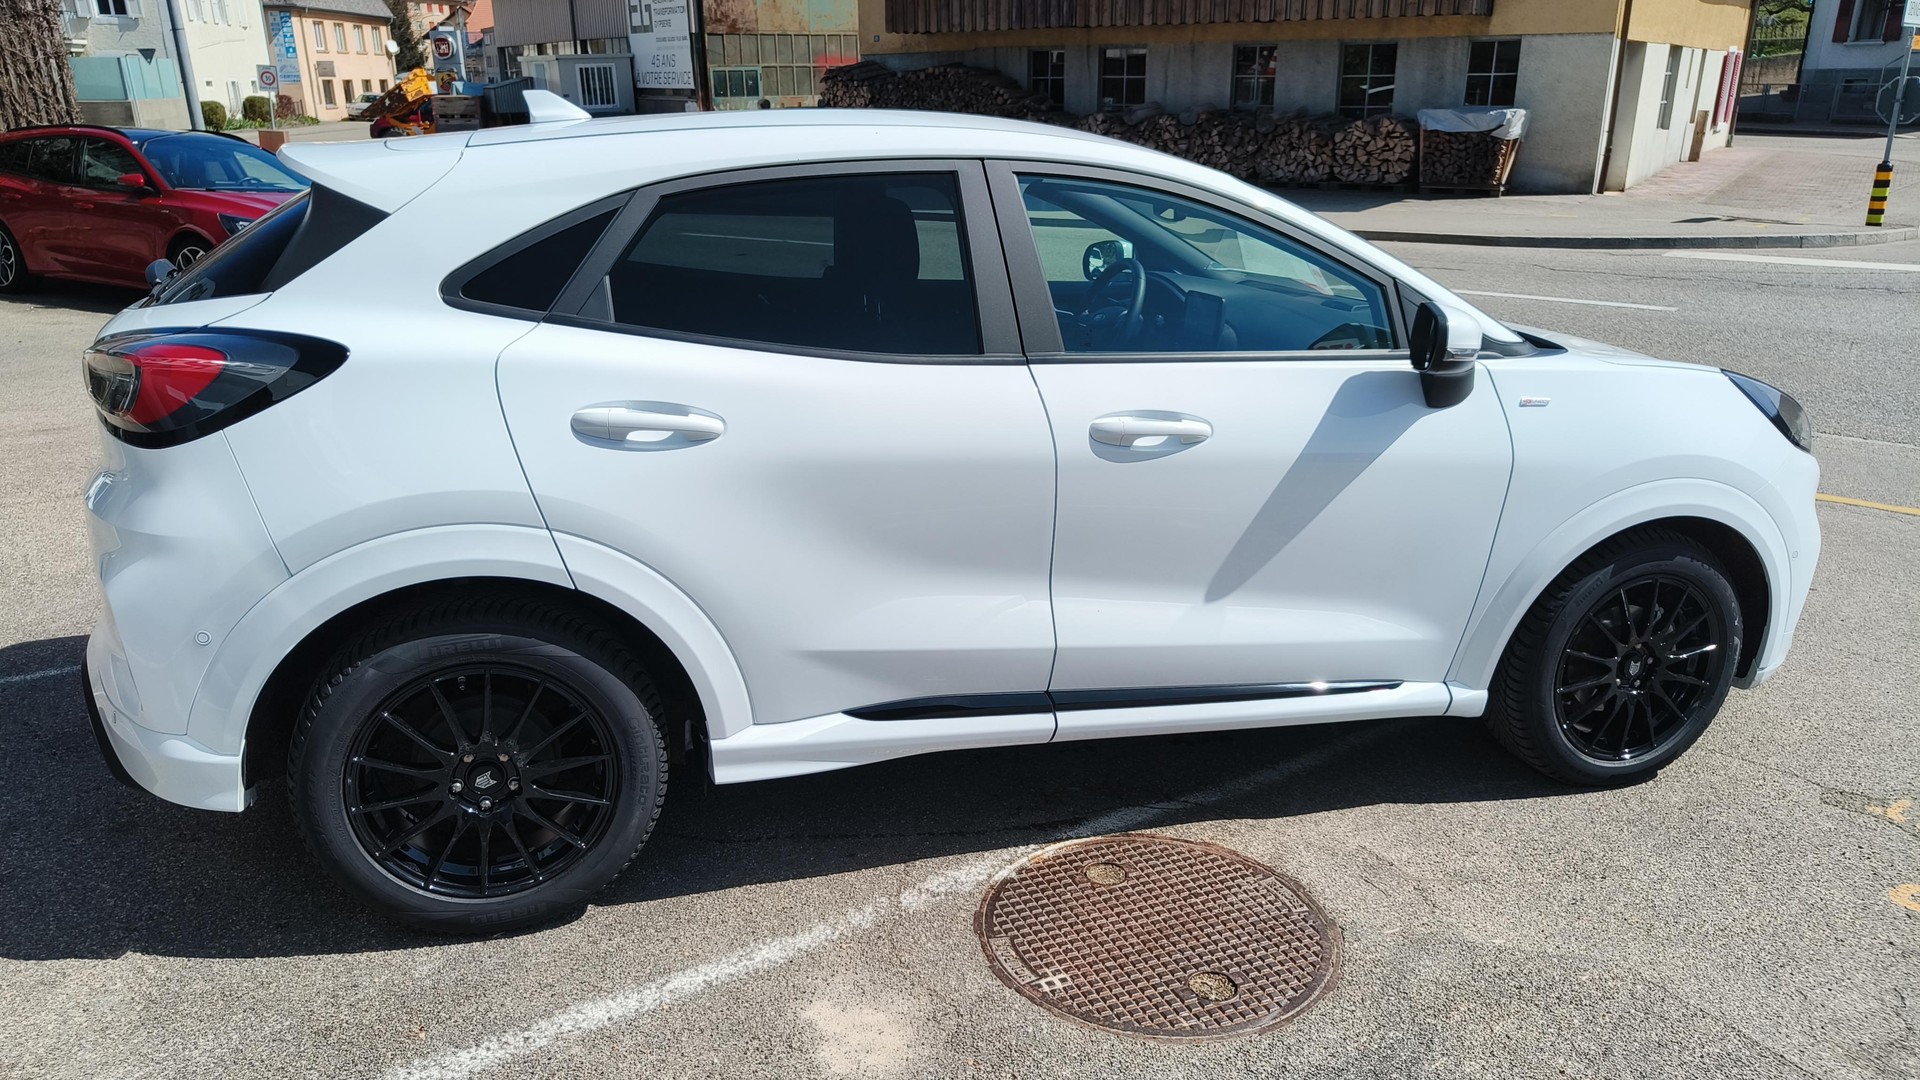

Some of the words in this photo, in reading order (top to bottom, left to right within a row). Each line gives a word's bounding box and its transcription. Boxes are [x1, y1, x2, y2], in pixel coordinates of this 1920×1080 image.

[651, 54, 661, 68] 45
[662, 54, 676, 68] ANS
[642, 71, 662, 85] VOTRE
[663, 71, 691, 85] SERVICE
